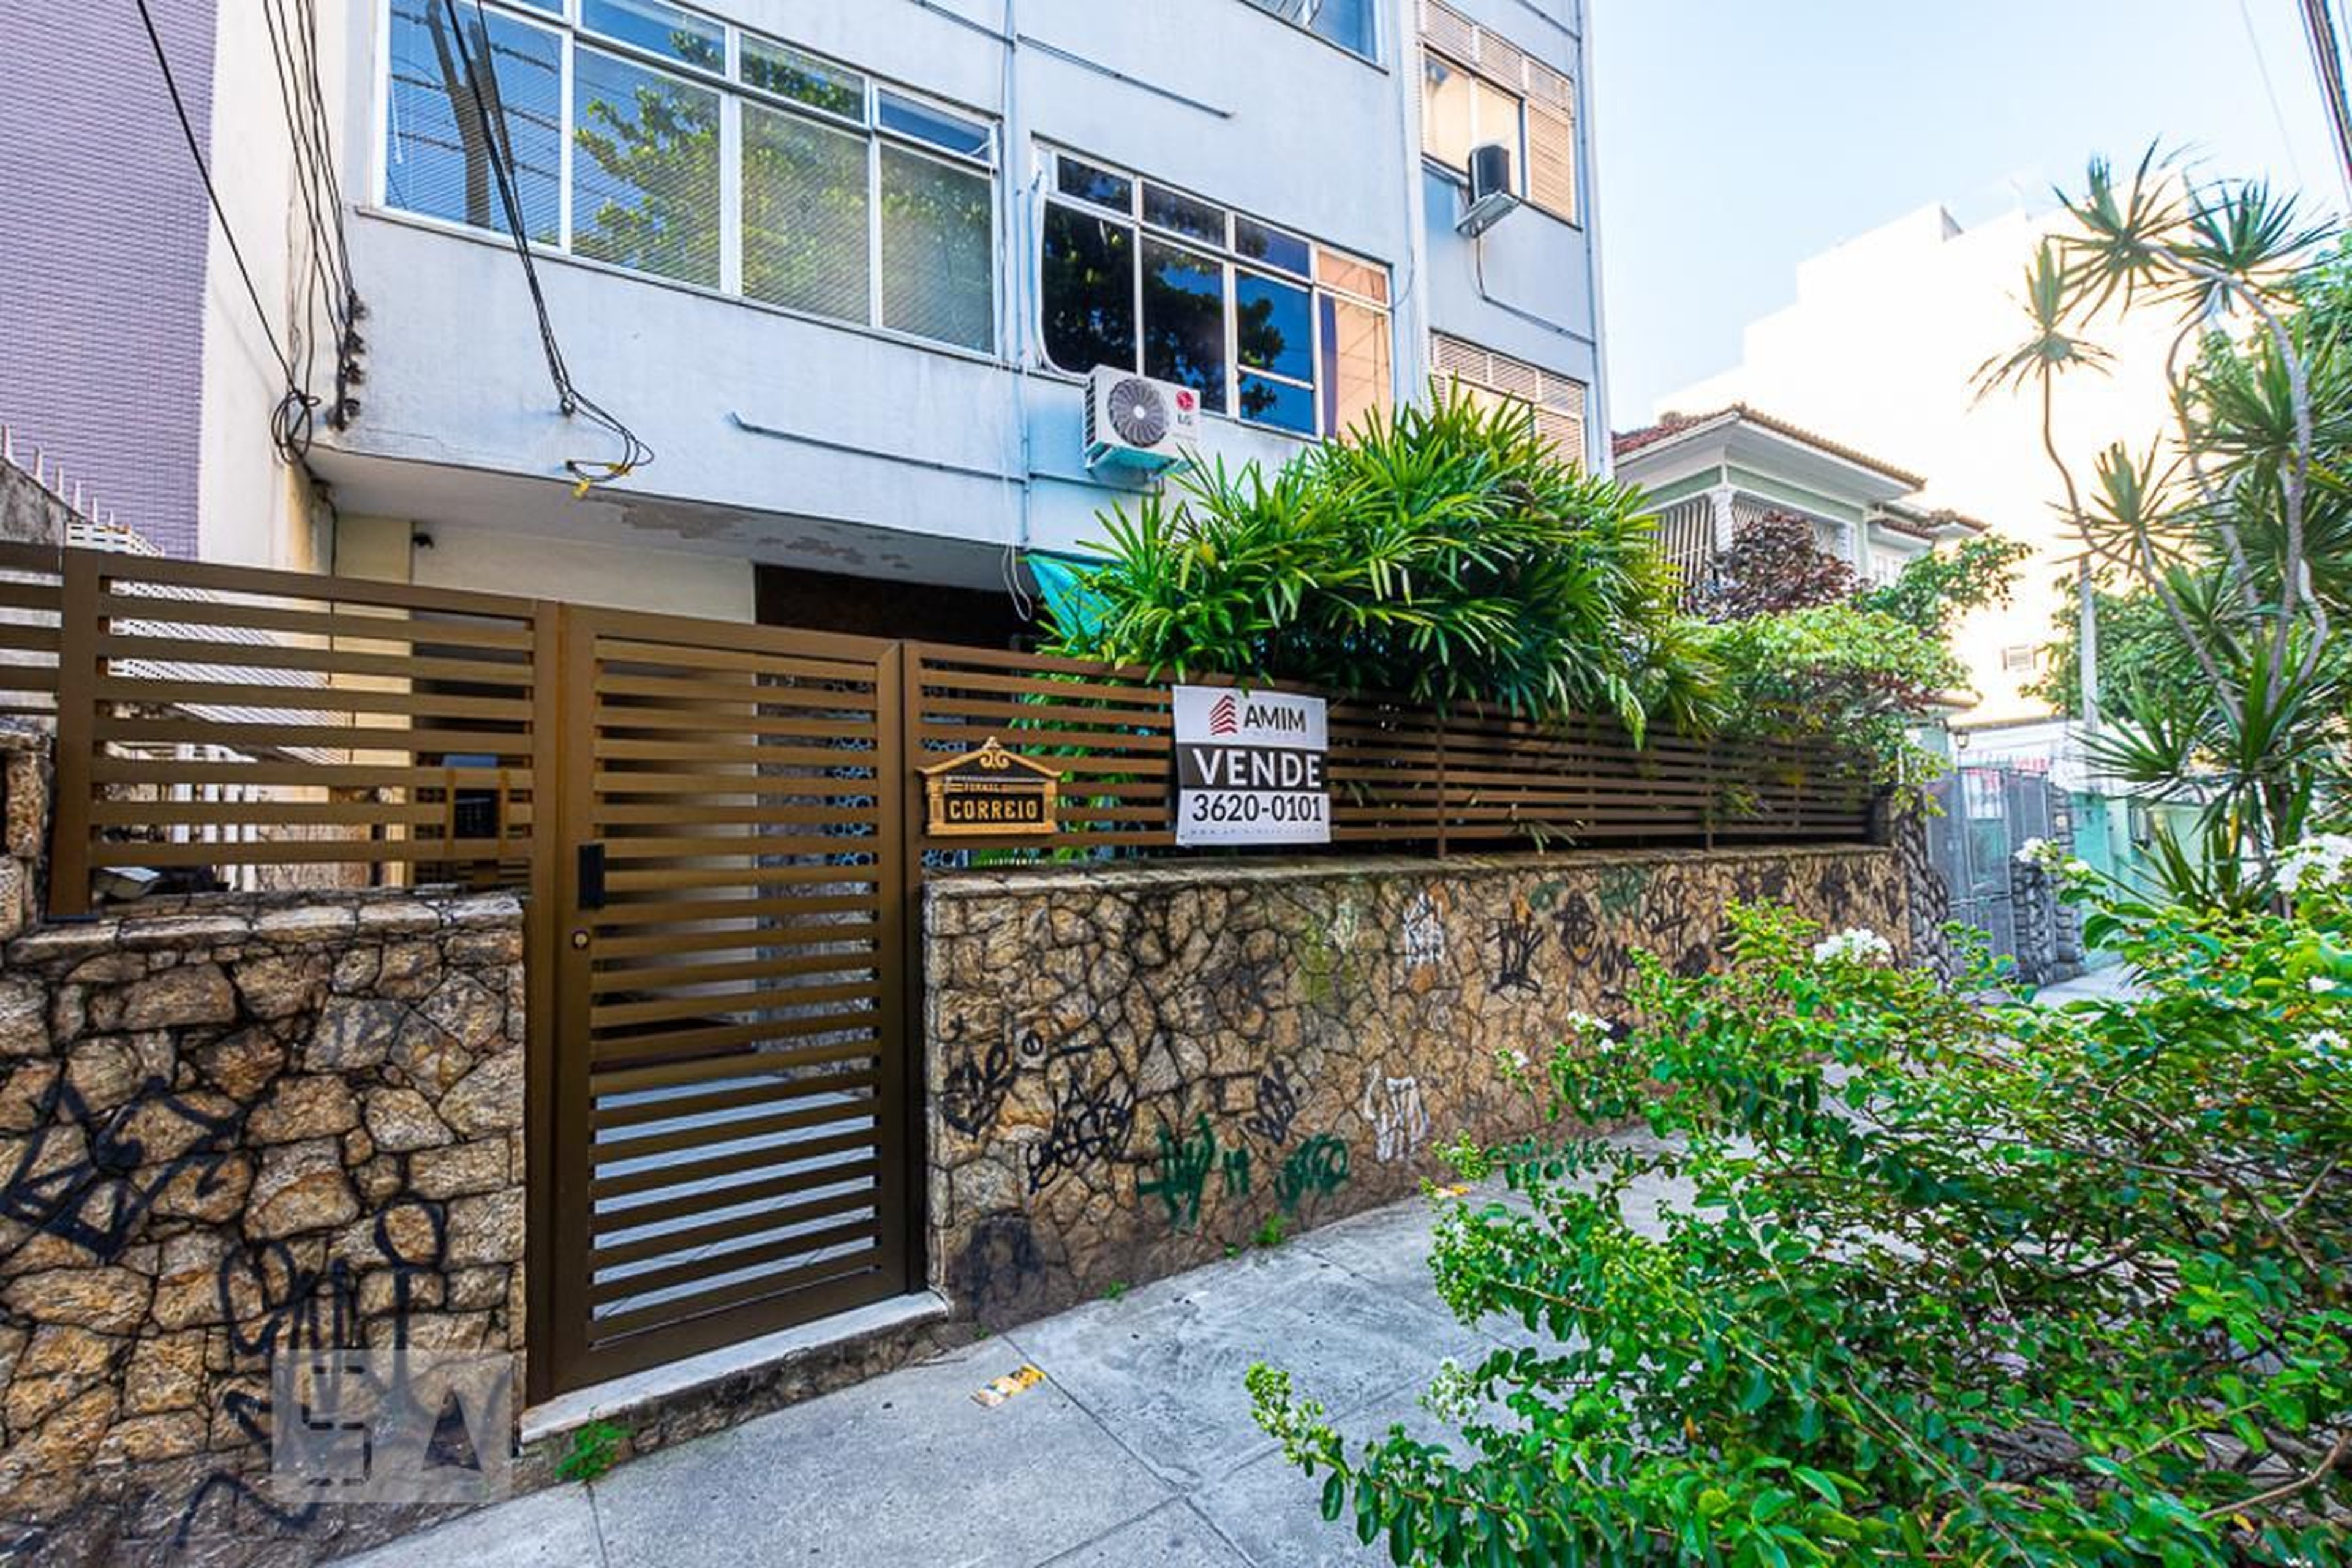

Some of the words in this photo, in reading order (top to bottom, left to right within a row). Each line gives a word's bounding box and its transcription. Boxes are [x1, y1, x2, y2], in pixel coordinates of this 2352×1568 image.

[1244, 705, 1306, 733] AMIM
[1193, 748, 1321, 788] VENDE
[950, 800, 1038, 820] CORREIO
[1192, 794, 1322, 821] 3620-0101
